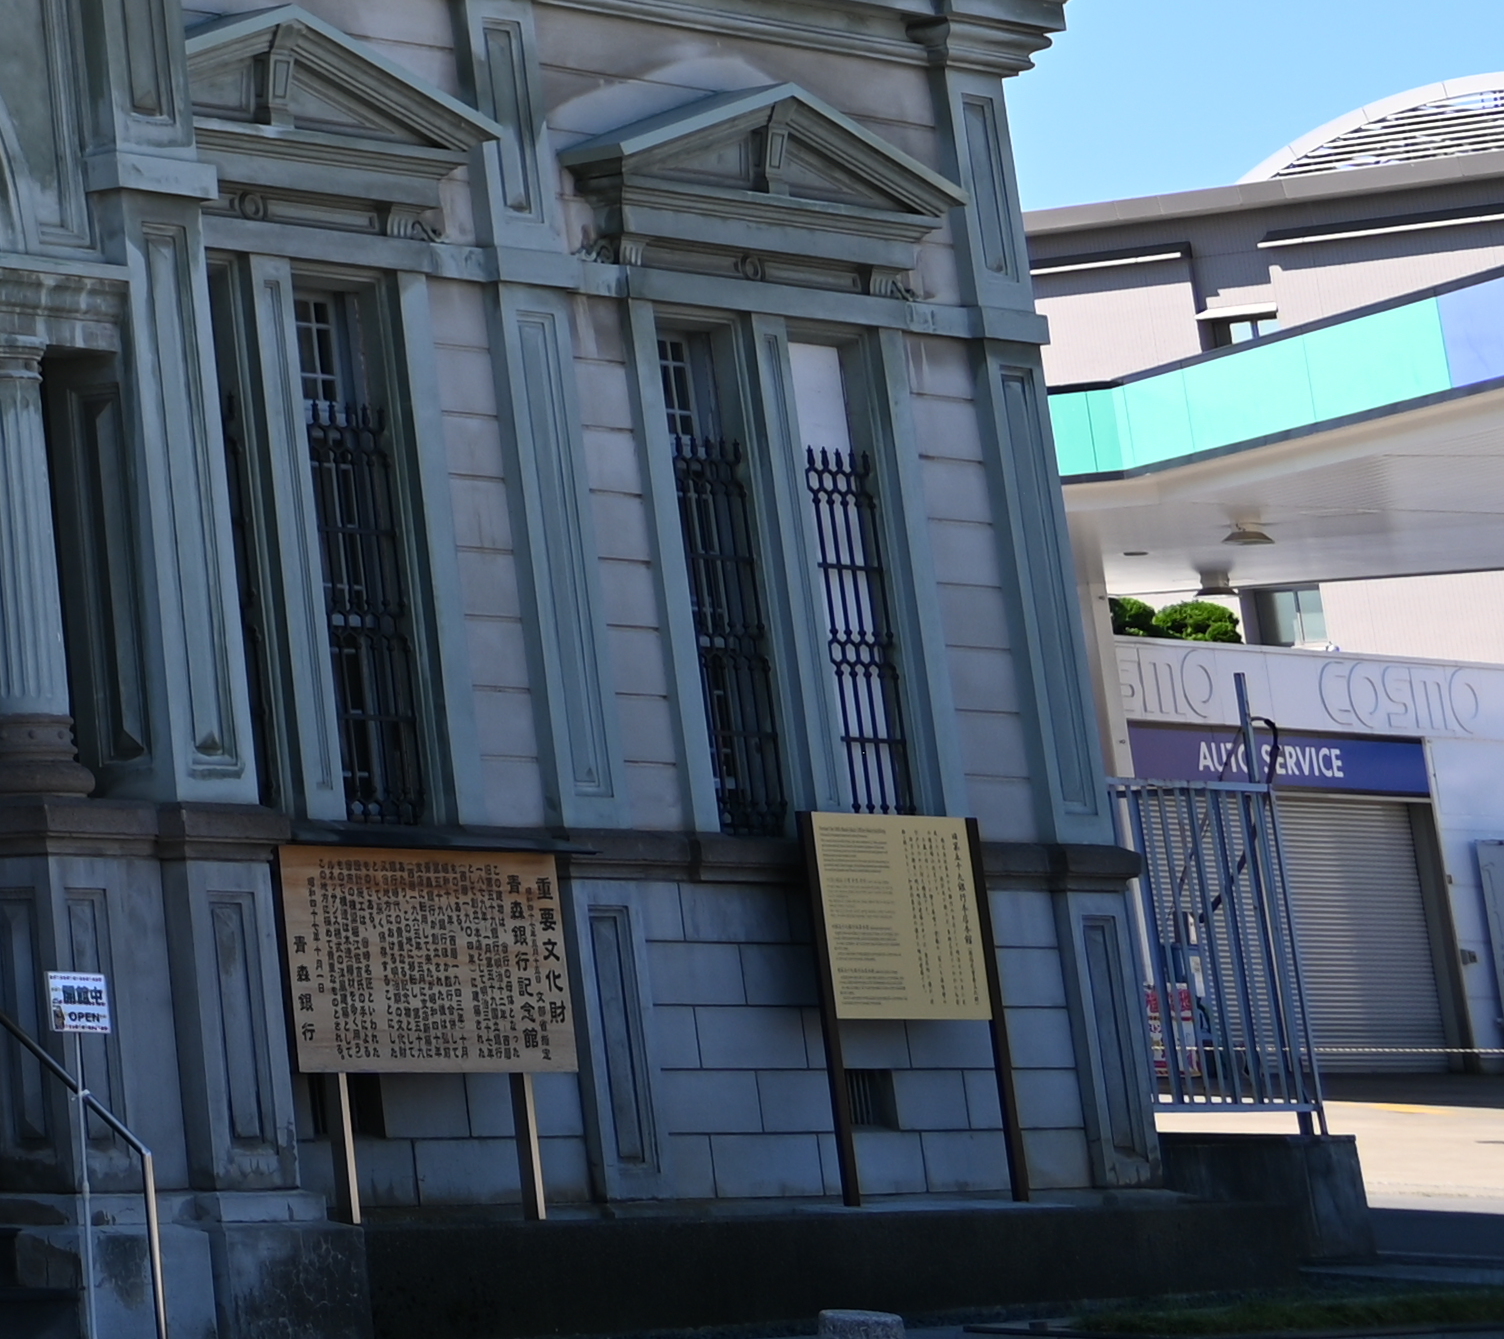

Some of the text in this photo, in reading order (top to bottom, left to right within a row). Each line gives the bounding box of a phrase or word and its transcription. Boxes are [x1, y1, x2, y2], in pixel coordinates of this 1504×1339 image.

[1261, 743, 1344, 777] SERVICE
[292, 934, 316, 1041] 青森銀行
[505, 874, 539, 1048] 青森銀行記念館
[533, 875, 567, 1023] 重要文化財
[69, 1011, 101, 1023] OPEN
